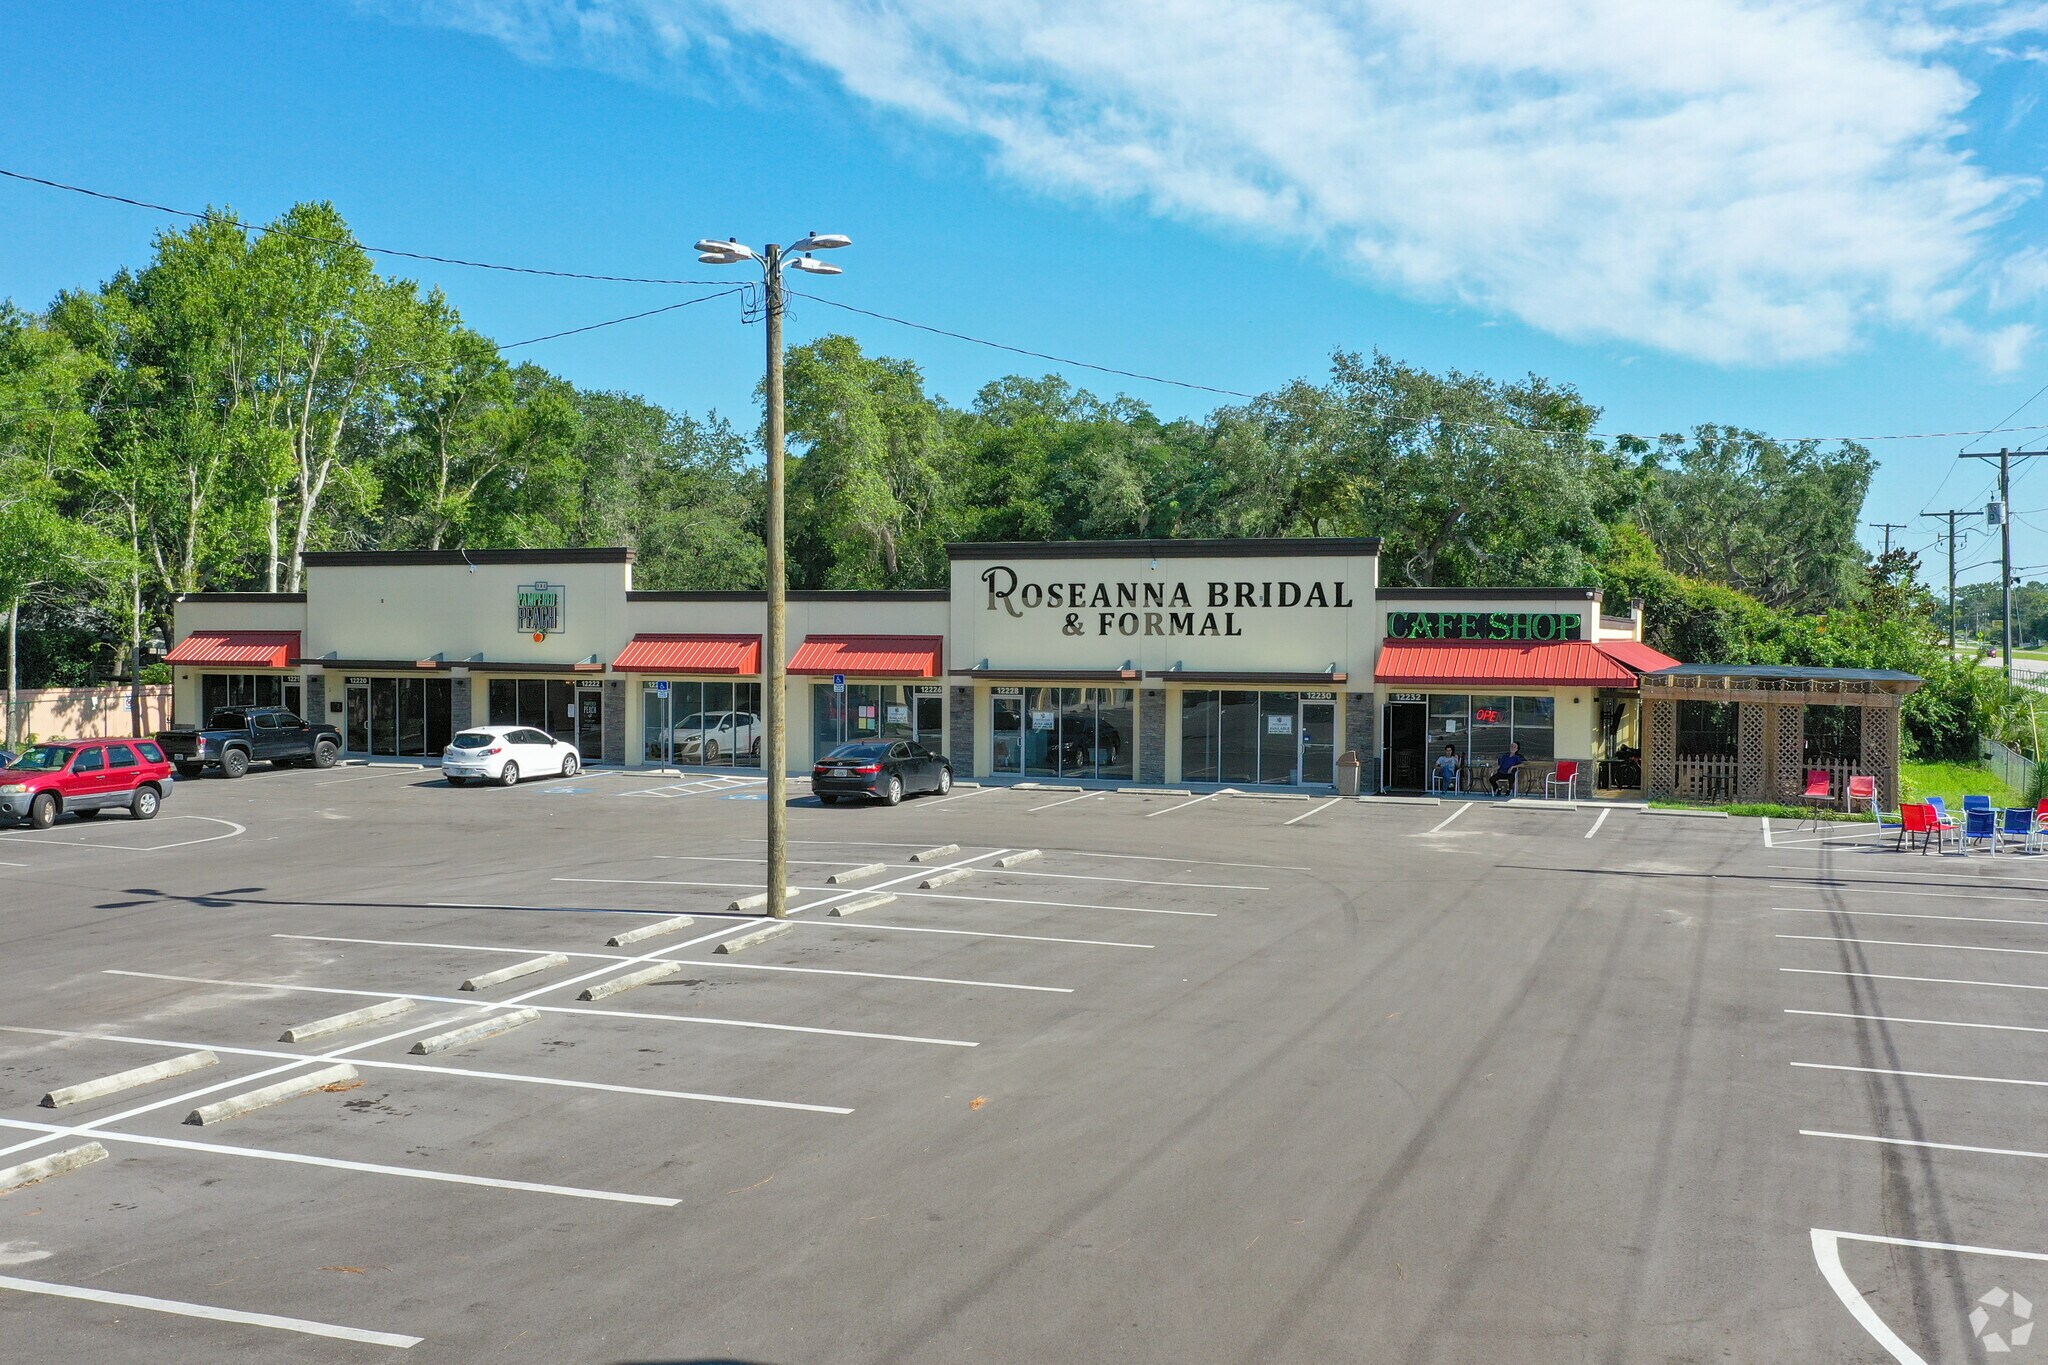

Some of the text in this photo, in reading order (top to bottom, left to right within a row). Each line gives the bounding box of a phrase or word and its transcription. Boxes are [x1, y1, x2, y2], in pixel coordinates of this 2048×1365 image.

[981, 566, 1353, 618] ROSEANNA BRIDAL
[518, 606, 557, 629] PEACH
[1062, 612, 1242, 637] & FORMAL
[1387, 612, 1581, 640] CAFE SHOP
